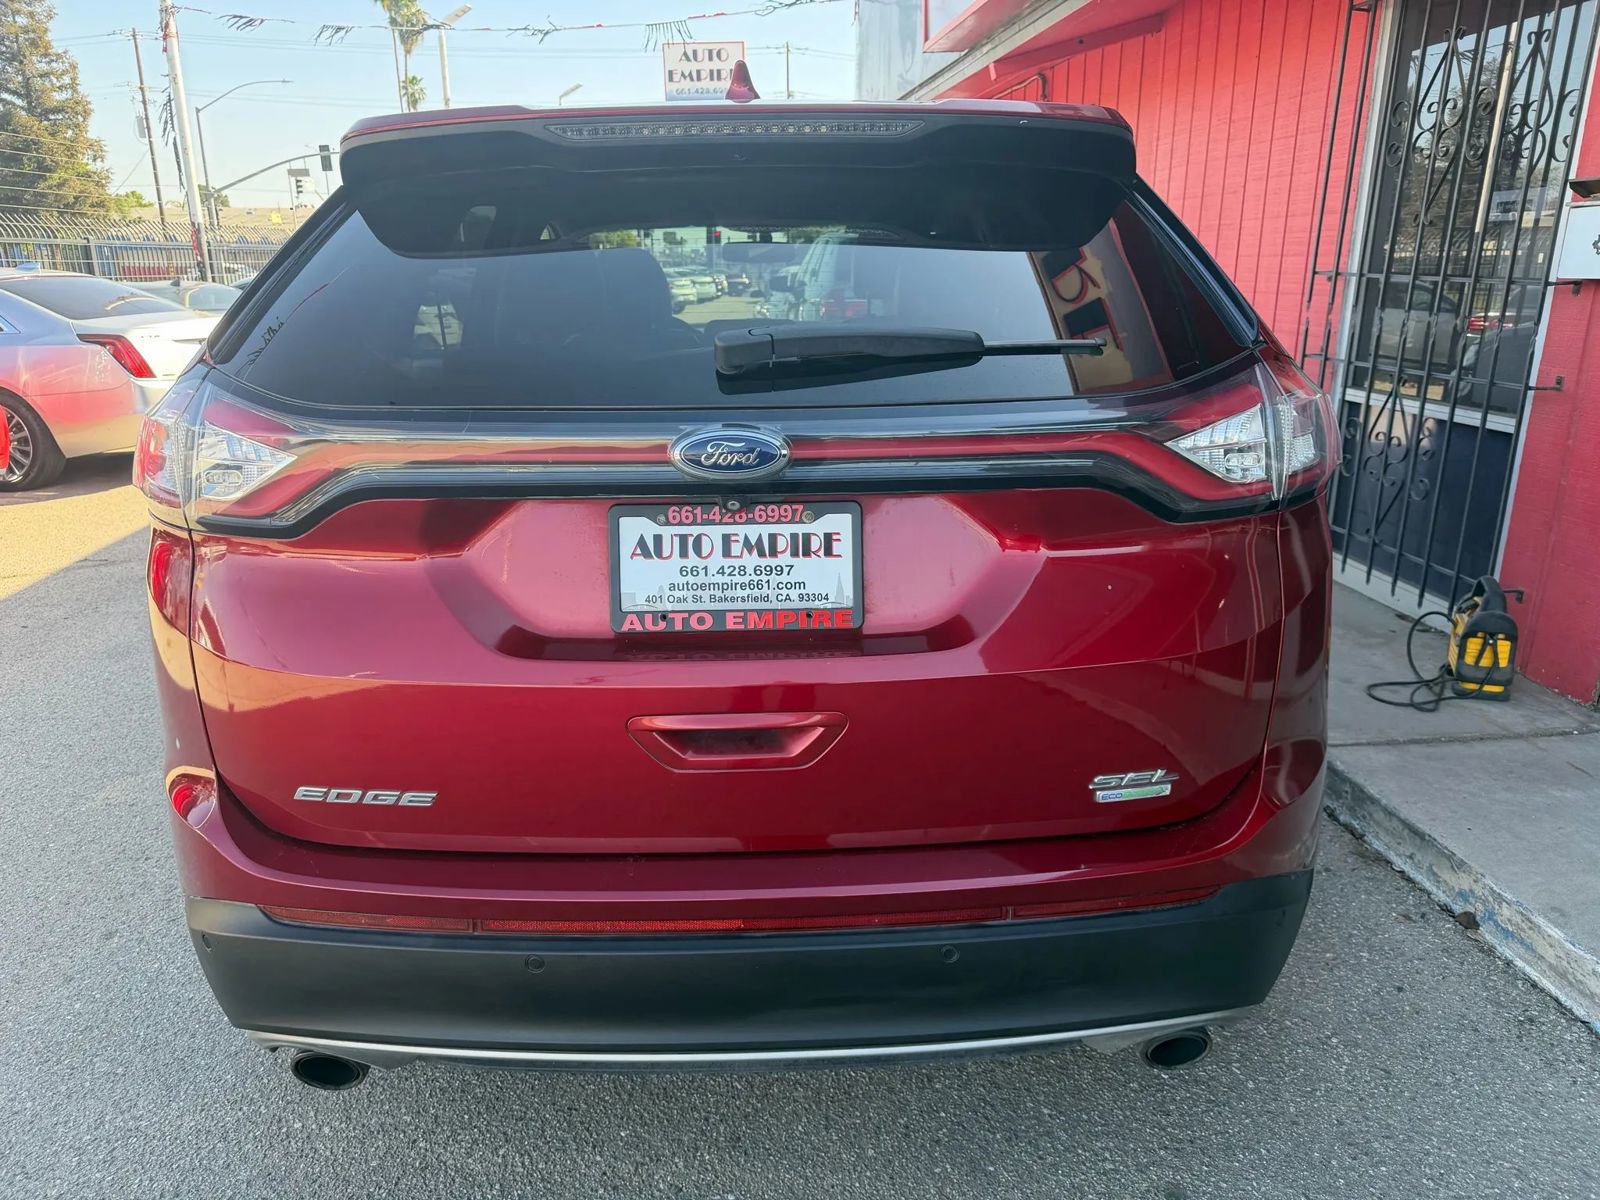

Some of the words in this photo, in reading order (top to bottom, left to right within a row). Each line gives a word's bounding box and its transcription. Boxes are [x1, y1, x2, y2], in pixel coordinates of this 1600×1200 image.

[679, 48, 729, 63] AUTO
[701, 441, 760, 466] Ford
[667, 504, 803, 524] 661-428-6997
[630, 532, 714, 560] AUTO
[721, 532, 843, 560] EMPIRE
[679, 564, 794, 577] 661.428.6997
[668, 579, 806, 593] autoempire661.com
[645, 594, 664, 605] 401
[667, 594, 689, 604] Oak
[691, 594, 706, 604] St.
[709, 593, 773, 605] Bakersfield,
[776, 593, 795, 603] CA.
[798, 592, 829, 602] 93304
[621, 612, 714, 632] AUTO
[726, 610, 854, 630] EMPIRE
[1088, 769, 1180, 789] SEL
[293, 786, 438, 806] EDGE
